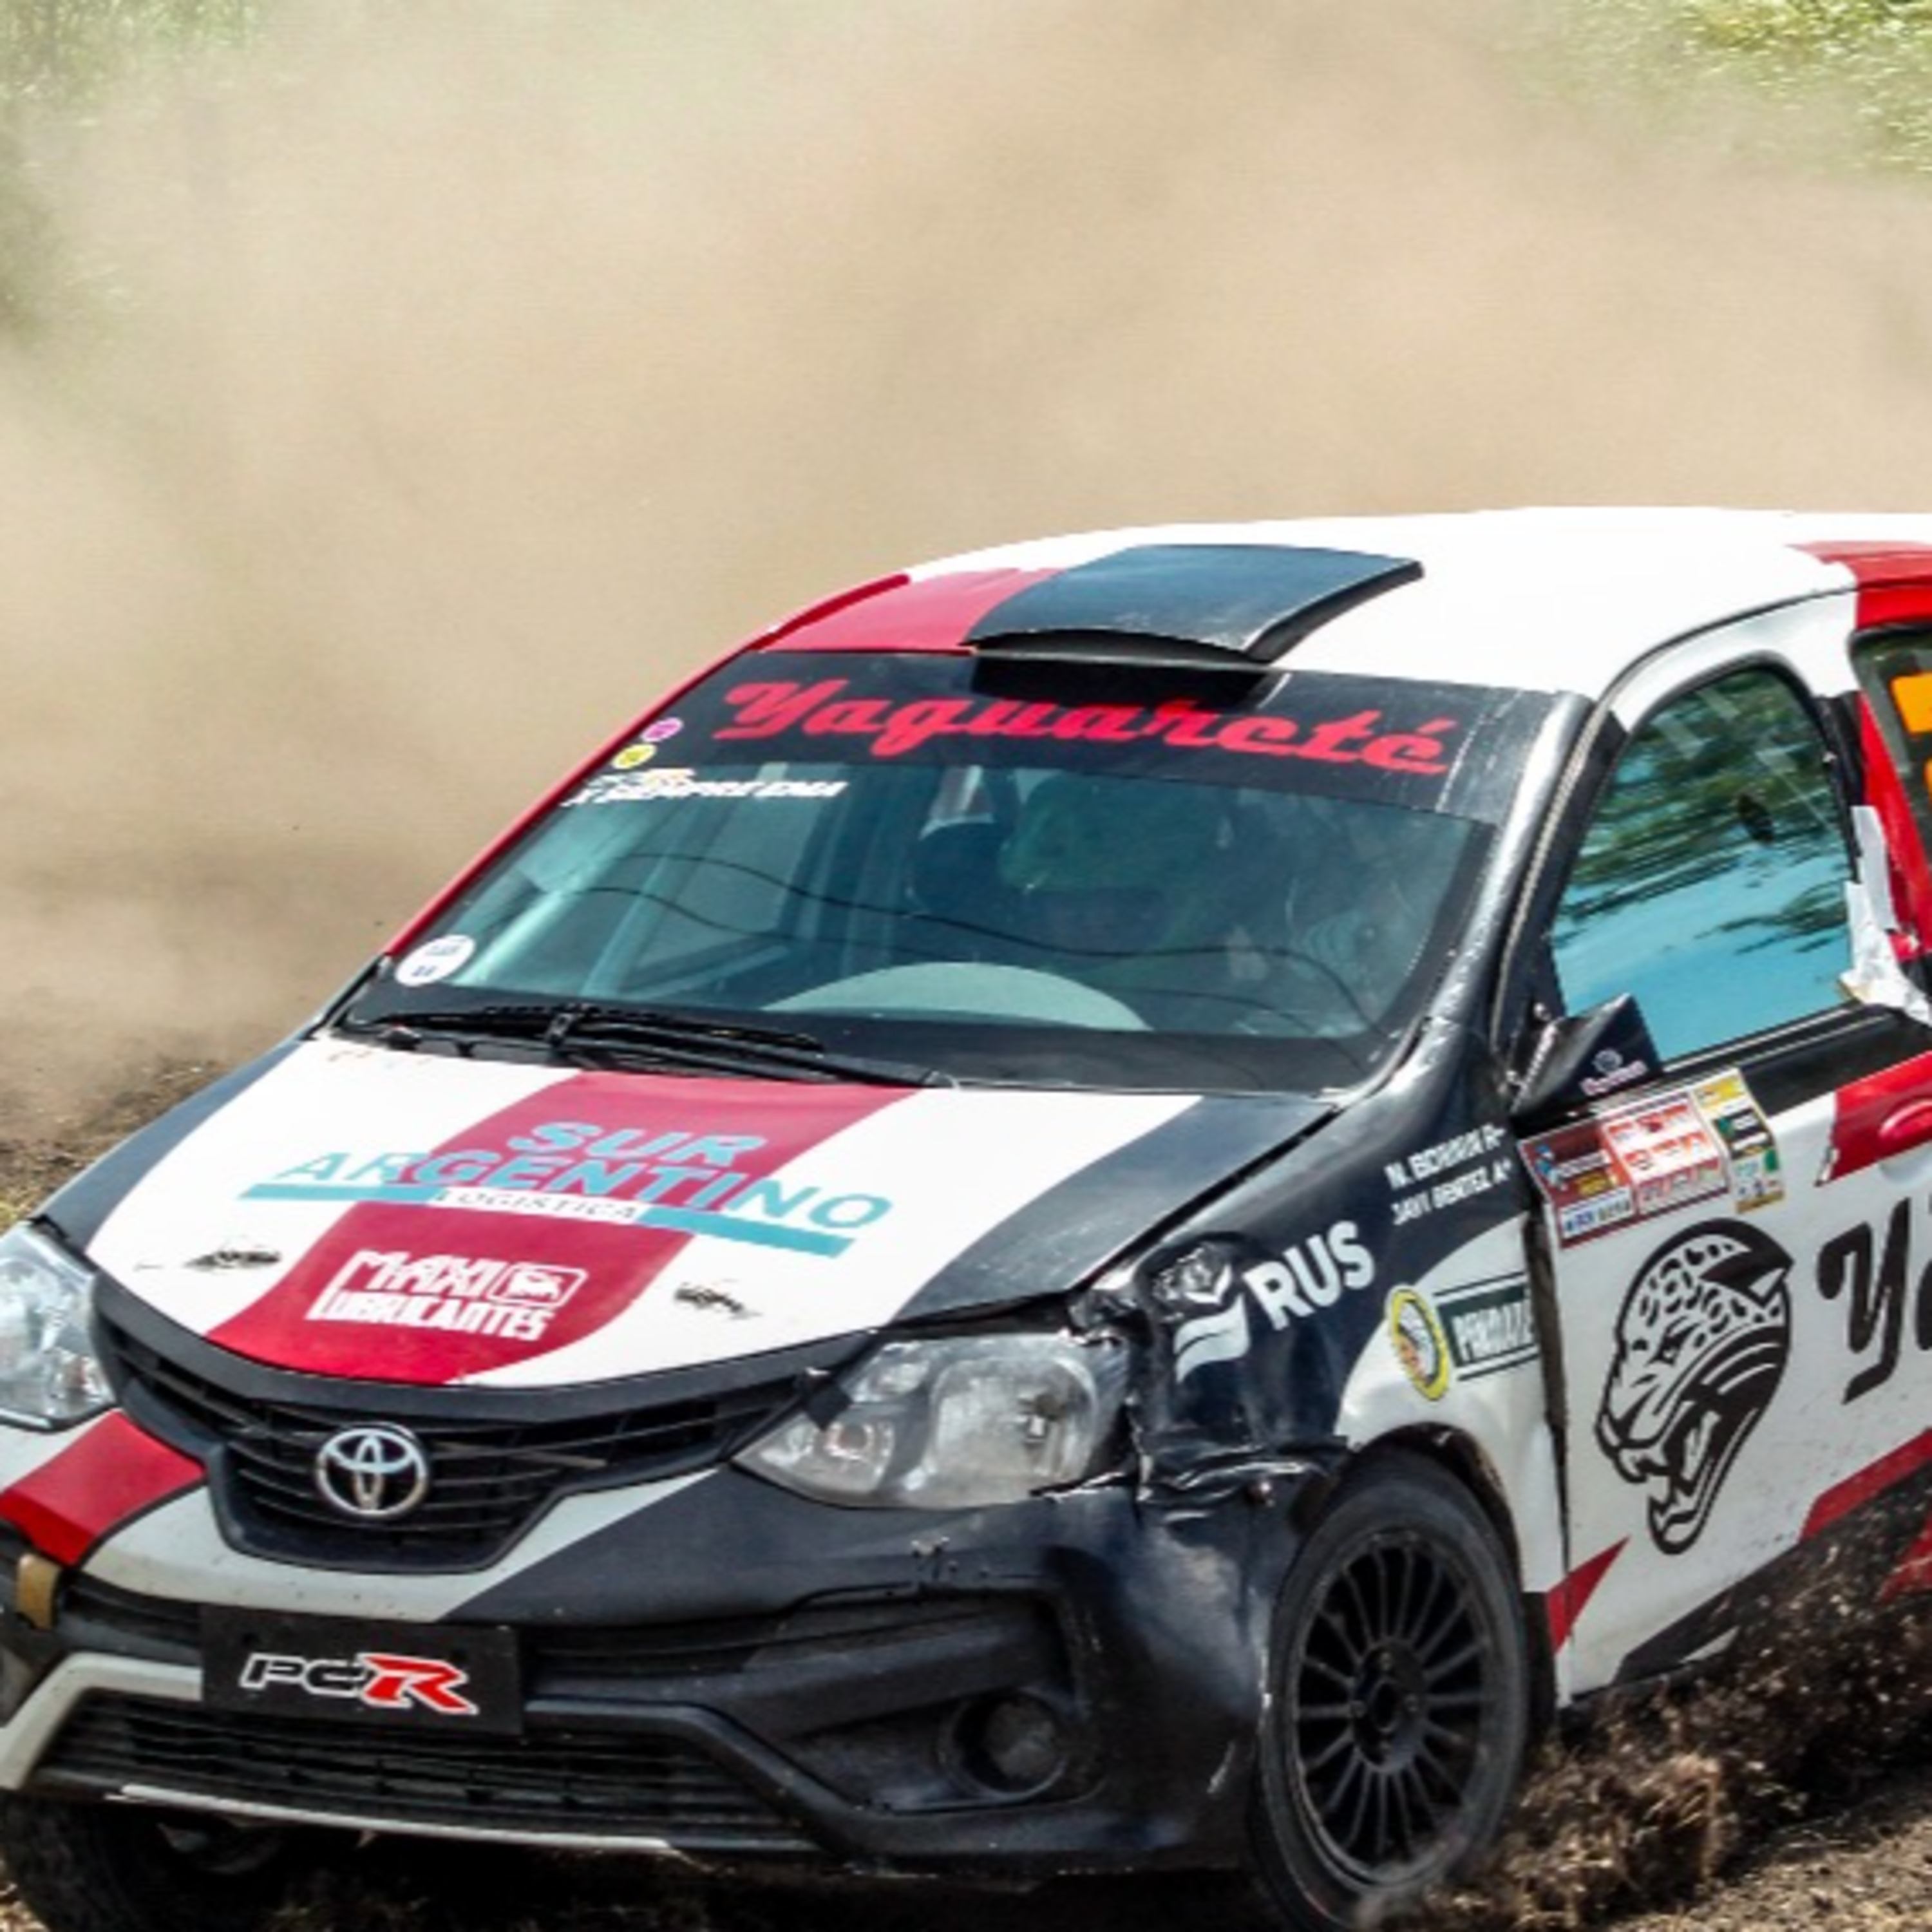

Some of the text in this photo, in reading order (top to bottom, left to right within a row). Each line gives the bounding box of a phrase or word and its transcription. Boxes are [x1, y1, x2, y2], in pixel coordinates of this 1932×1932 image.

[713, 679, 1448, 775] Yaguareté
[507, 1121, 768, 1167] SUR
[276, 1150, 892, 1229] ARGENTINO
[321, 1249, 509, 1298] MAXI
[1241, 1220, 1376, 1331] RUS
[239, 1652, 480, 1716] PCR
